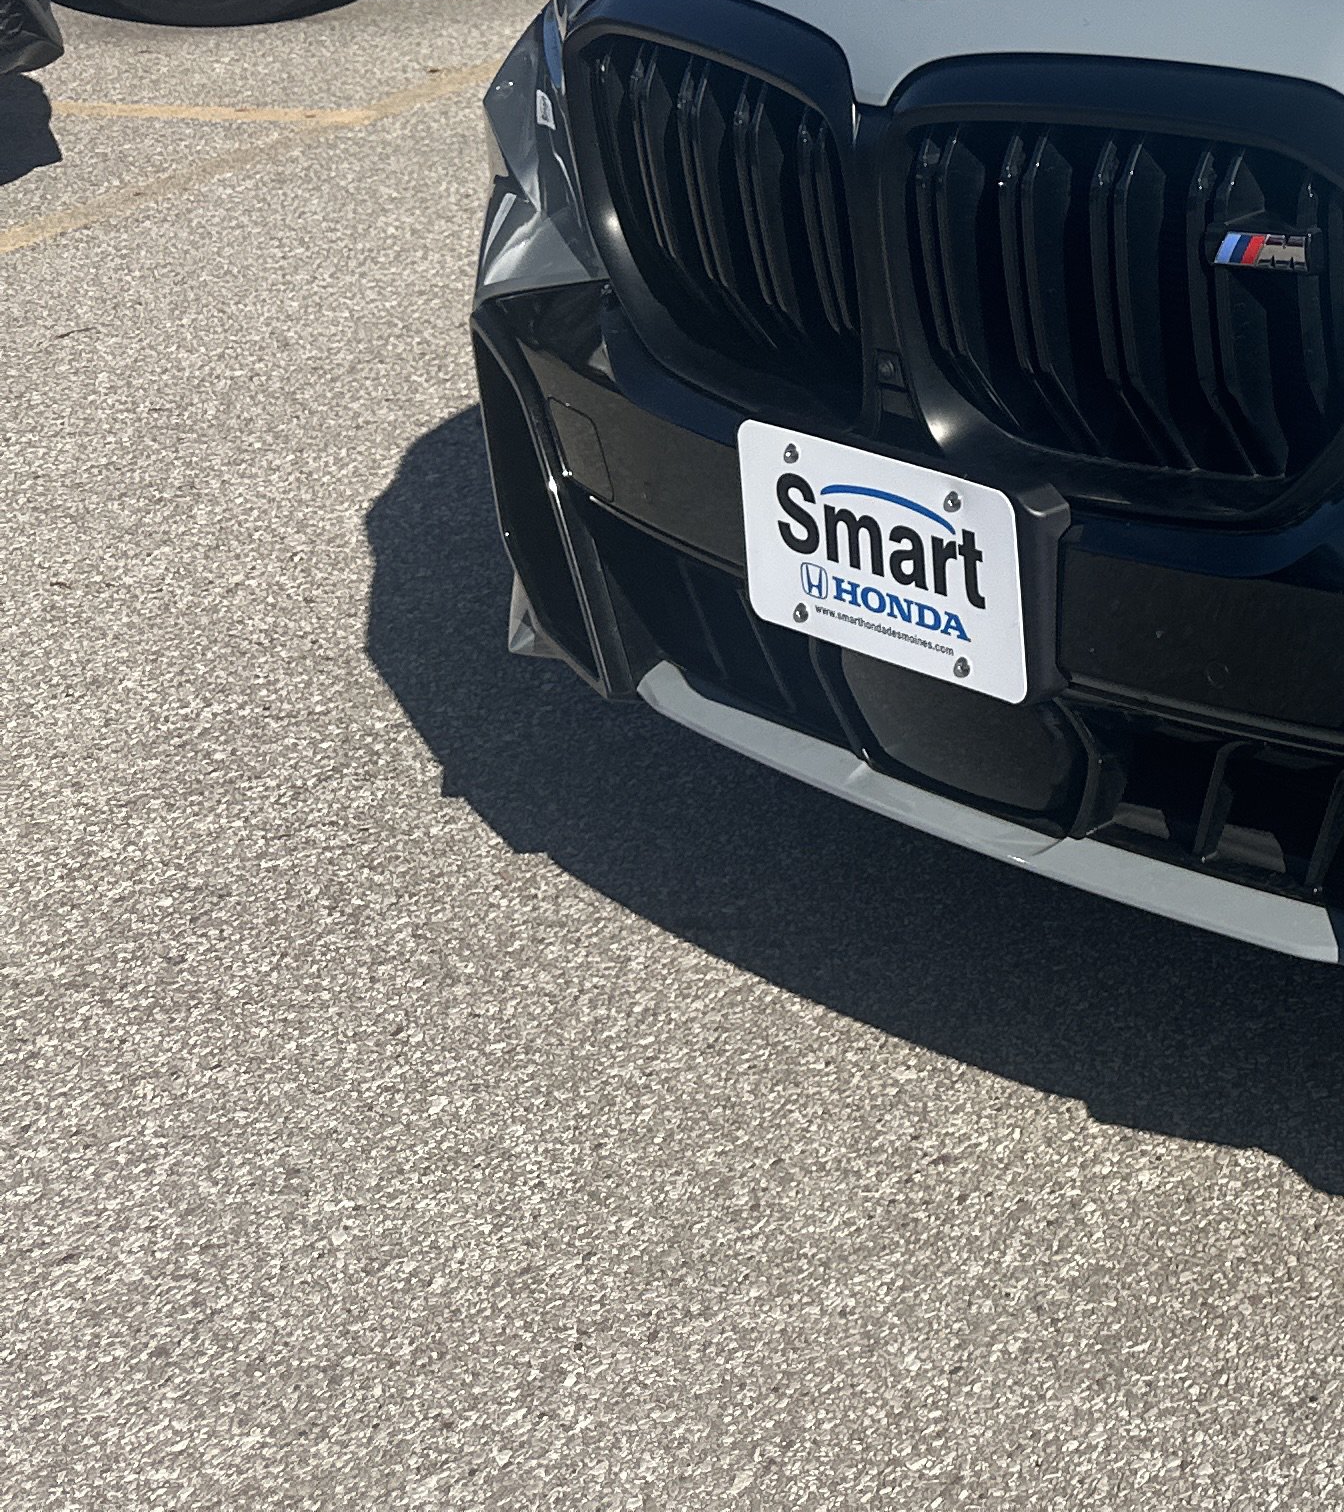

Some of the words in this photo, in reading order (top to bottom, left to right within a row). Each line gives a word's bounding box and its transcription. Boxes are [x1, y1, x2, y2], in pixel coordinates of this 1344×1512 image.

[776, 472, 987, 610] Smart
[814, 605, 955, 657] www.smarthondadesmoines.com
[832, 576, 972, 643] HONDA
